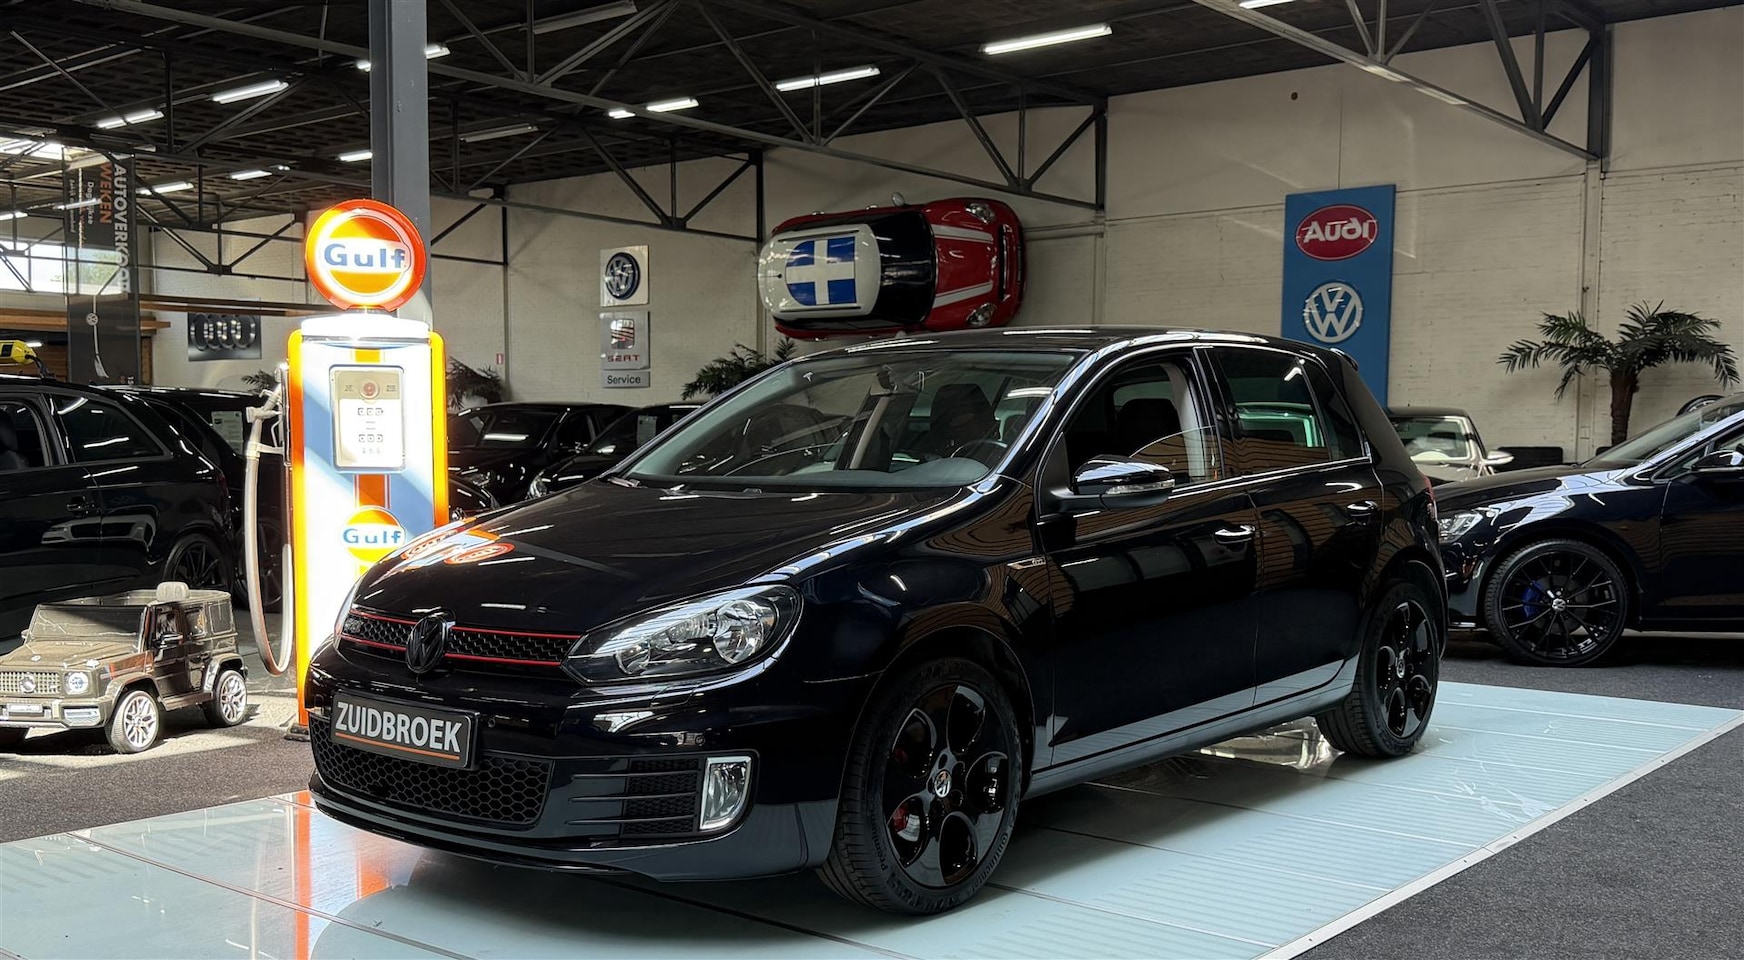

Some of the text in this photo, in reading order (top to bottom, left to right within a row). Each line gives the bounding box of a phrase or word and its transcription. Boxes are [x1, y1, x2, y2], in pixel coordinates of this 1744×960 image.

[99, 162, 113, 224] WEKEN
[1302, 217, 1373, 243] Audi
[324, 243, 405, 269] Gulf
[607, 354, 641, 362] SEAT
[607, 374, 641, 385] Service
[343, 528, 402, 545] Gulf
[335, 701, 462, 753] ZUIDBROEK
